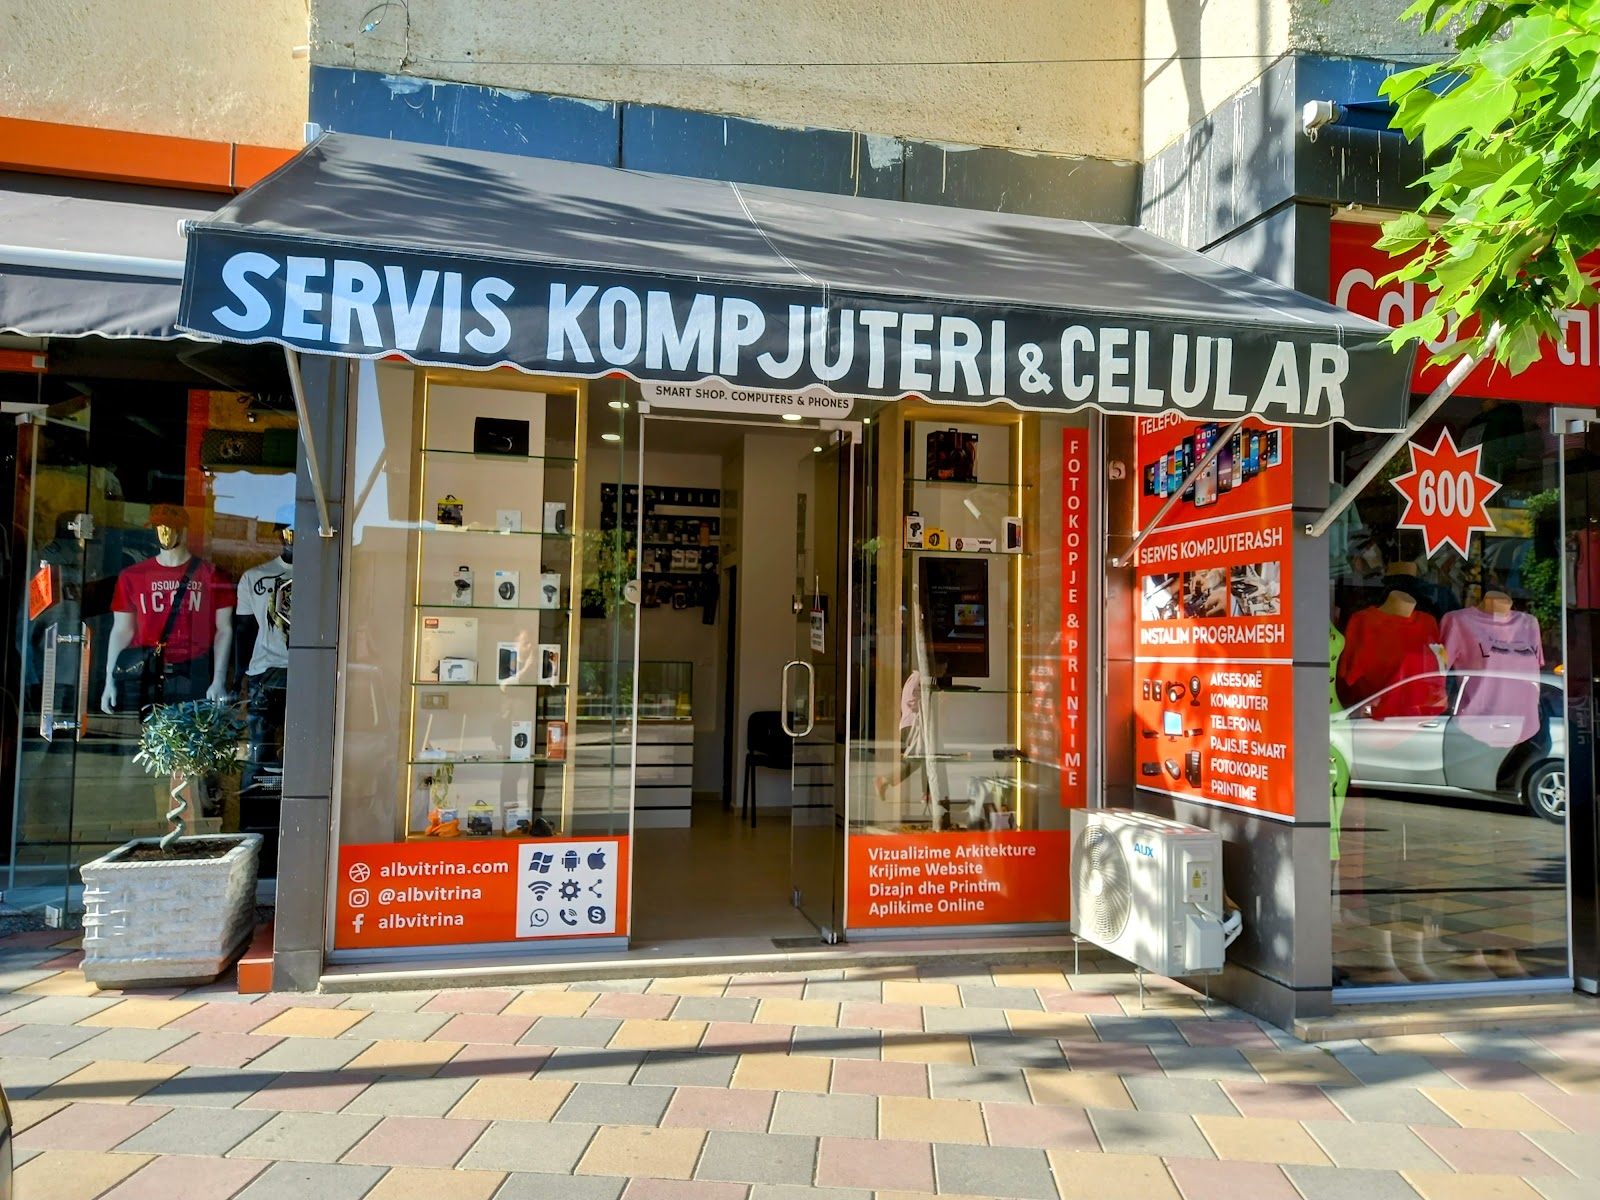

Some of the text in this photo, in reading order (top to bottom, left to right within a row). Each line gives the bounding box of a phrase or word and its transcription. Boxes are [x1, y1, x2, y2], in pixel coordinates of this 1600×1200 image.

[212, 252, 1350, 417] SERVIS KOMPJUTERI & CELULAR
[655, 385, 849, 409] SMART SHOP. COMPUTERS & PHONES
[1141, 412, 1187, 436] TELEFO
[1418, 469, 1475, 517] 600
[1141, 526, 1283, 565] SERVIS KOMPJUTERASH
[1064, 440, 1081, 787] FOTOKOPJE & PRINTIME
[1140, 624, 1285, 645] INSTALIM PROGRAMESH
[1210, 670, 1262, 689] AKSESORË
[1210, 692, 1269, 711] KOMPJUTER
[1210, 714, 1262, 734] TELEFONA
[1210, 735, 1287, 760] PAJISJE SMART
[1210, 757, 1269, 780] FOTOKOPJE
[1211, 779, 1257, 802] PRINTIME
[868, 843, 1036, 861] Vizualizime Arkitekture
[1134, 843, 1154, 857] AUX
[380, 860, 509, 878] albvitrina.com
[868, 861, 983, 880] Krijime Website
[378, 886, 482, 905] @albvitrina
[869, 879, 1001, 899] Dizajn dhe Printim
[868, 898, 985, 918] Aplikime Online
[378, 912, 464, 929] albvitrina
